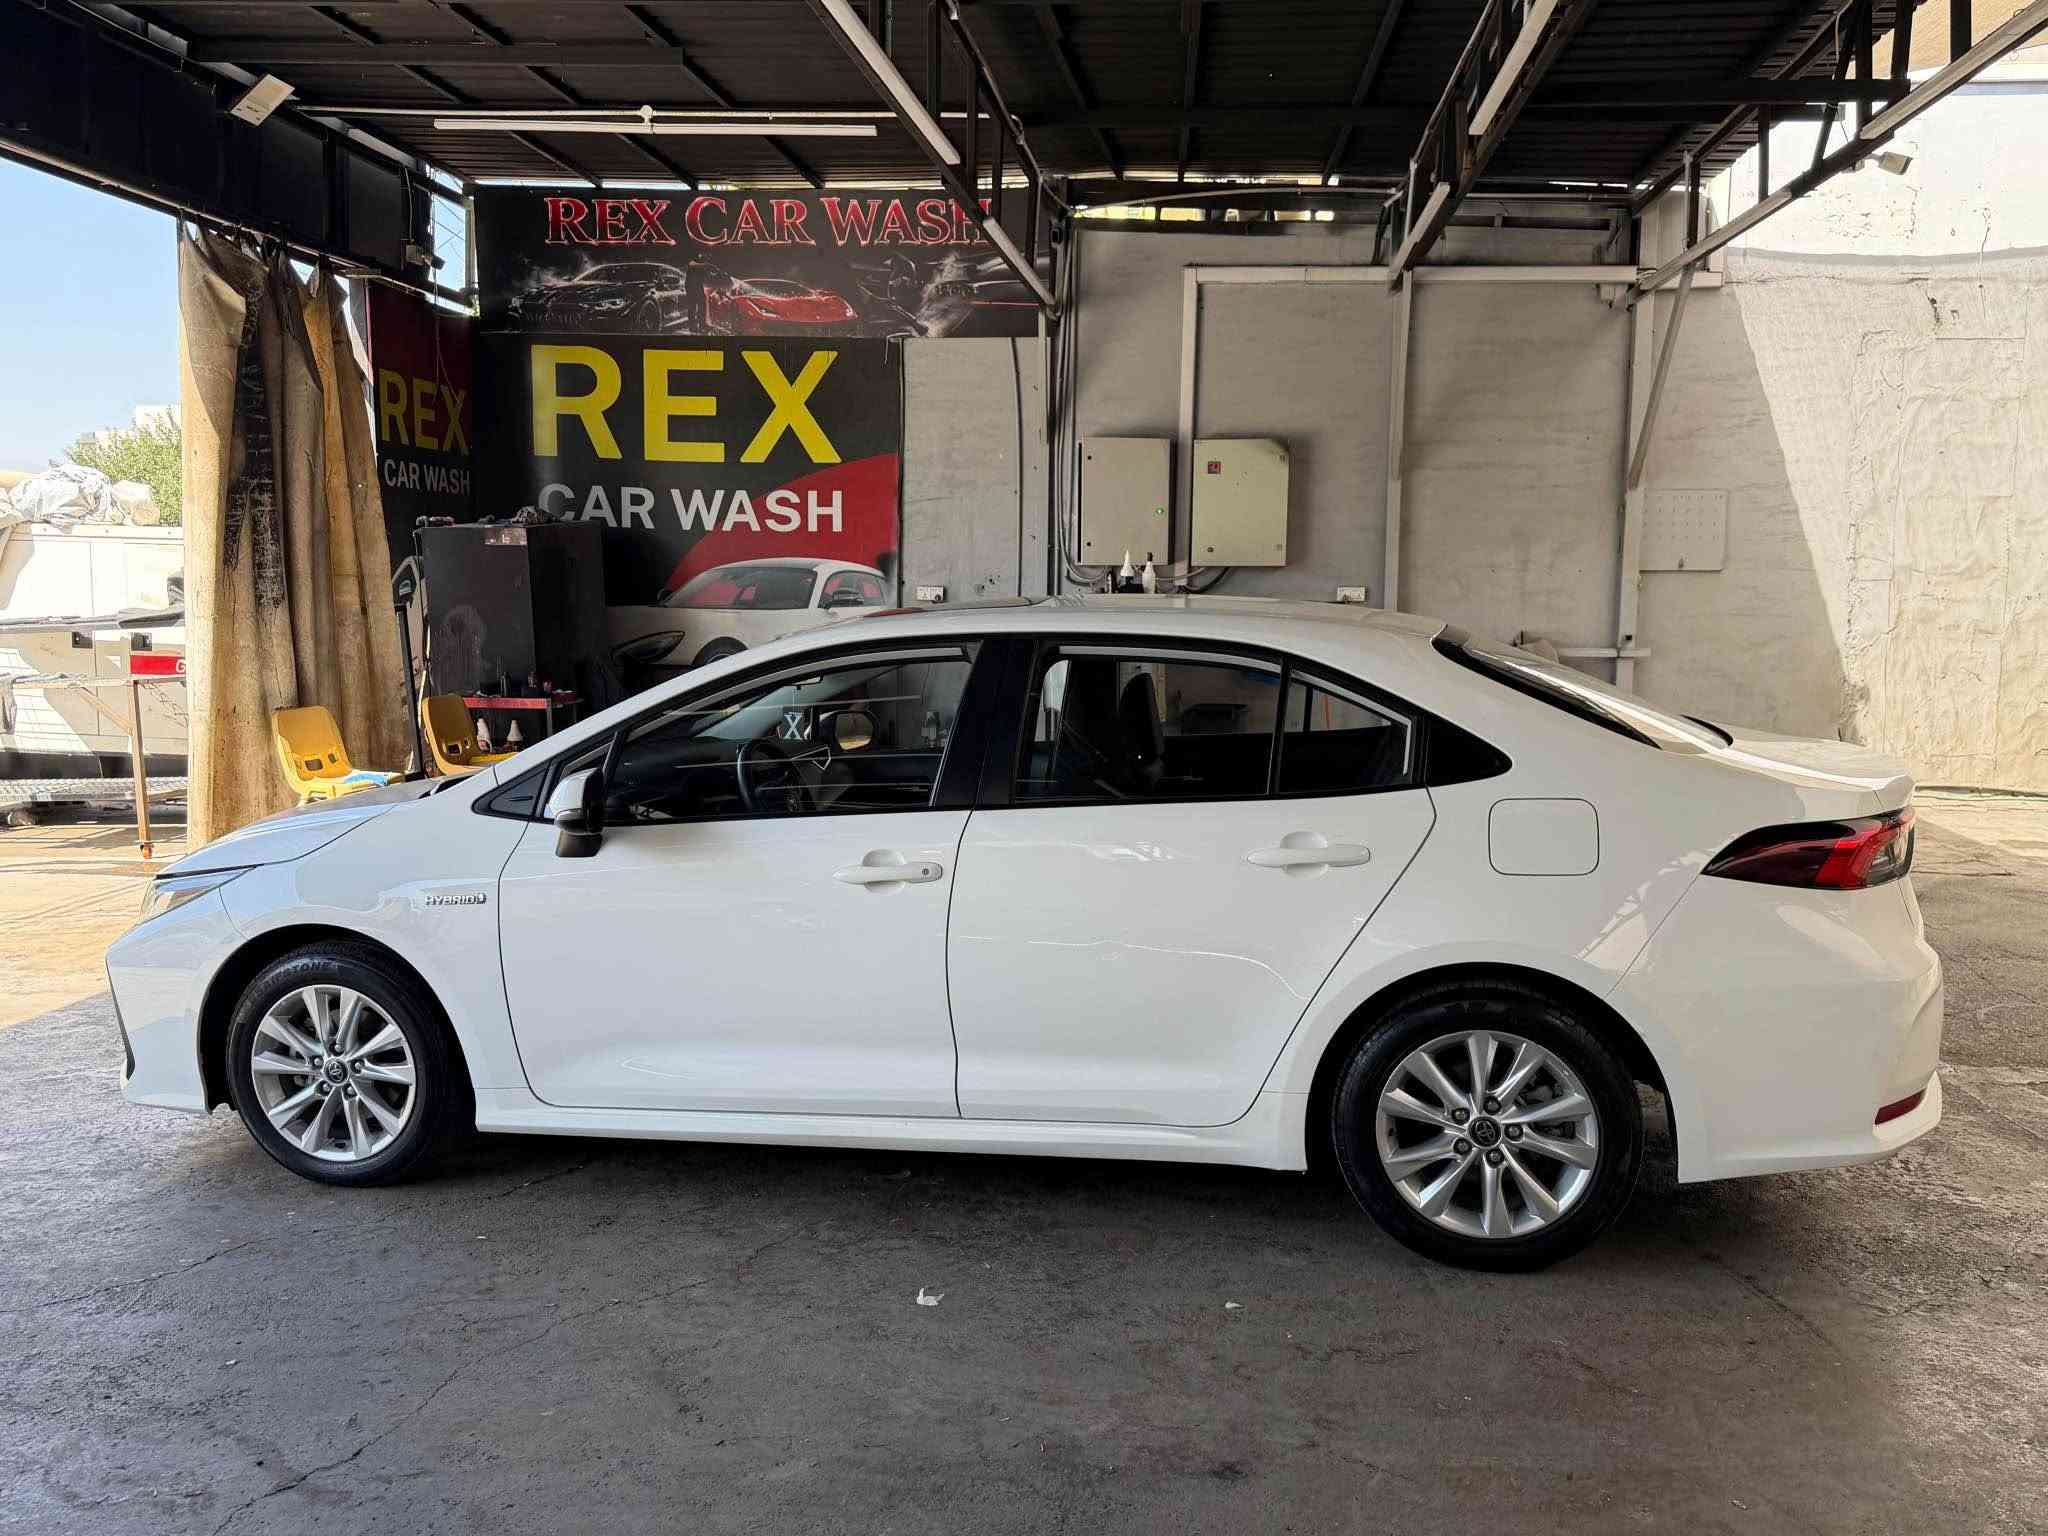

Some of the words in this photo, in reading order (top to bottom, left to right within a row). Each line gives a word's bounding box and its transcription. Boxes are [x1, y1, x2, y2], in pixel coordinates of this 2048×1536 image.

[544, 196, 676, 246] REX
[685, 196, 817, 245] CAR
[820, 197, 992, 247] WASH
[380, 368, 469, 455] REX
[531, 344, 843, 464] REX
[384, 459, 420, 490] CAR
[423, 464, 471, 496] WASH
[538, 483, 655, 530] CAR
[670, 488, 843, 533] WASH
